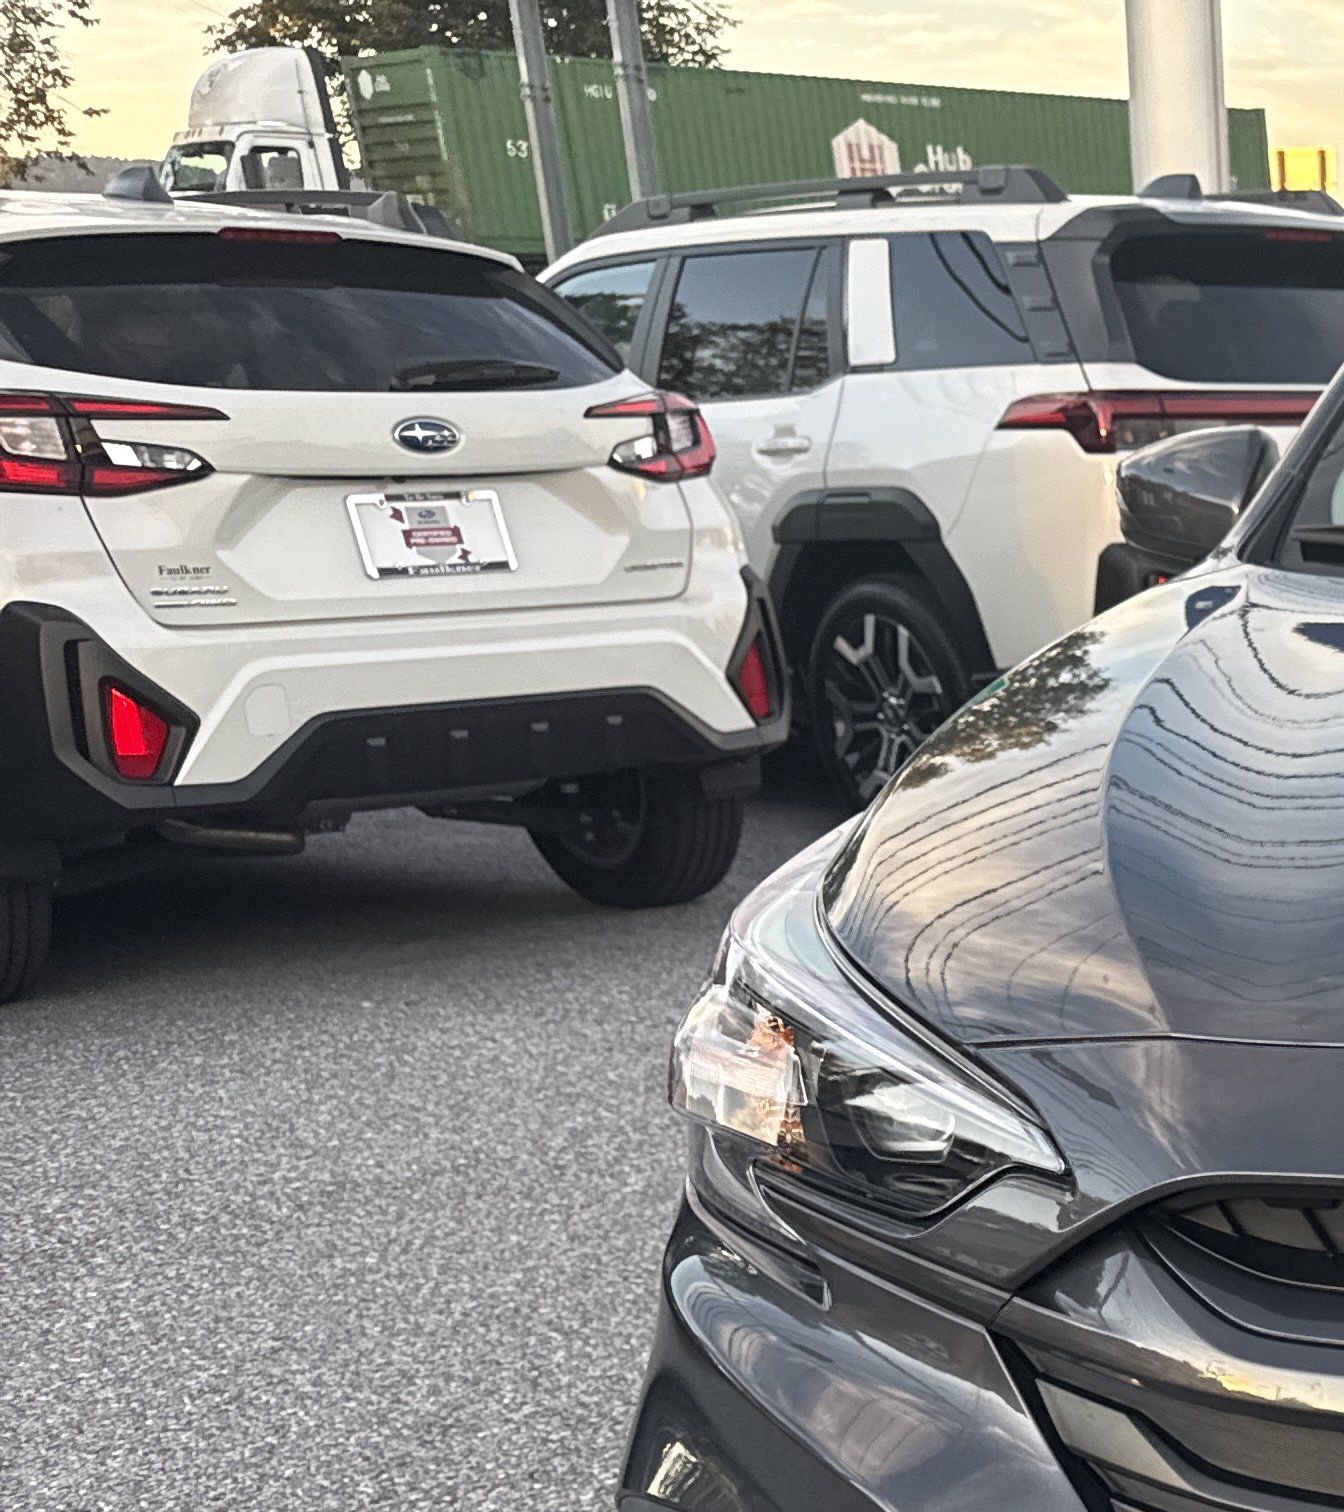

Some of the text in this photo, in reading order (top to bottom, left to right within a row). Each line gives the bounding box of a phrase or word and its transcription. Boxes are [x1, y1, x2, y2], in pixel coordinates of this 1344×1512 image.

[506, 138, 529, 159] 53
[926, 143, 973, 172] Hub
[157, 564, 212, 576] Faulkner
